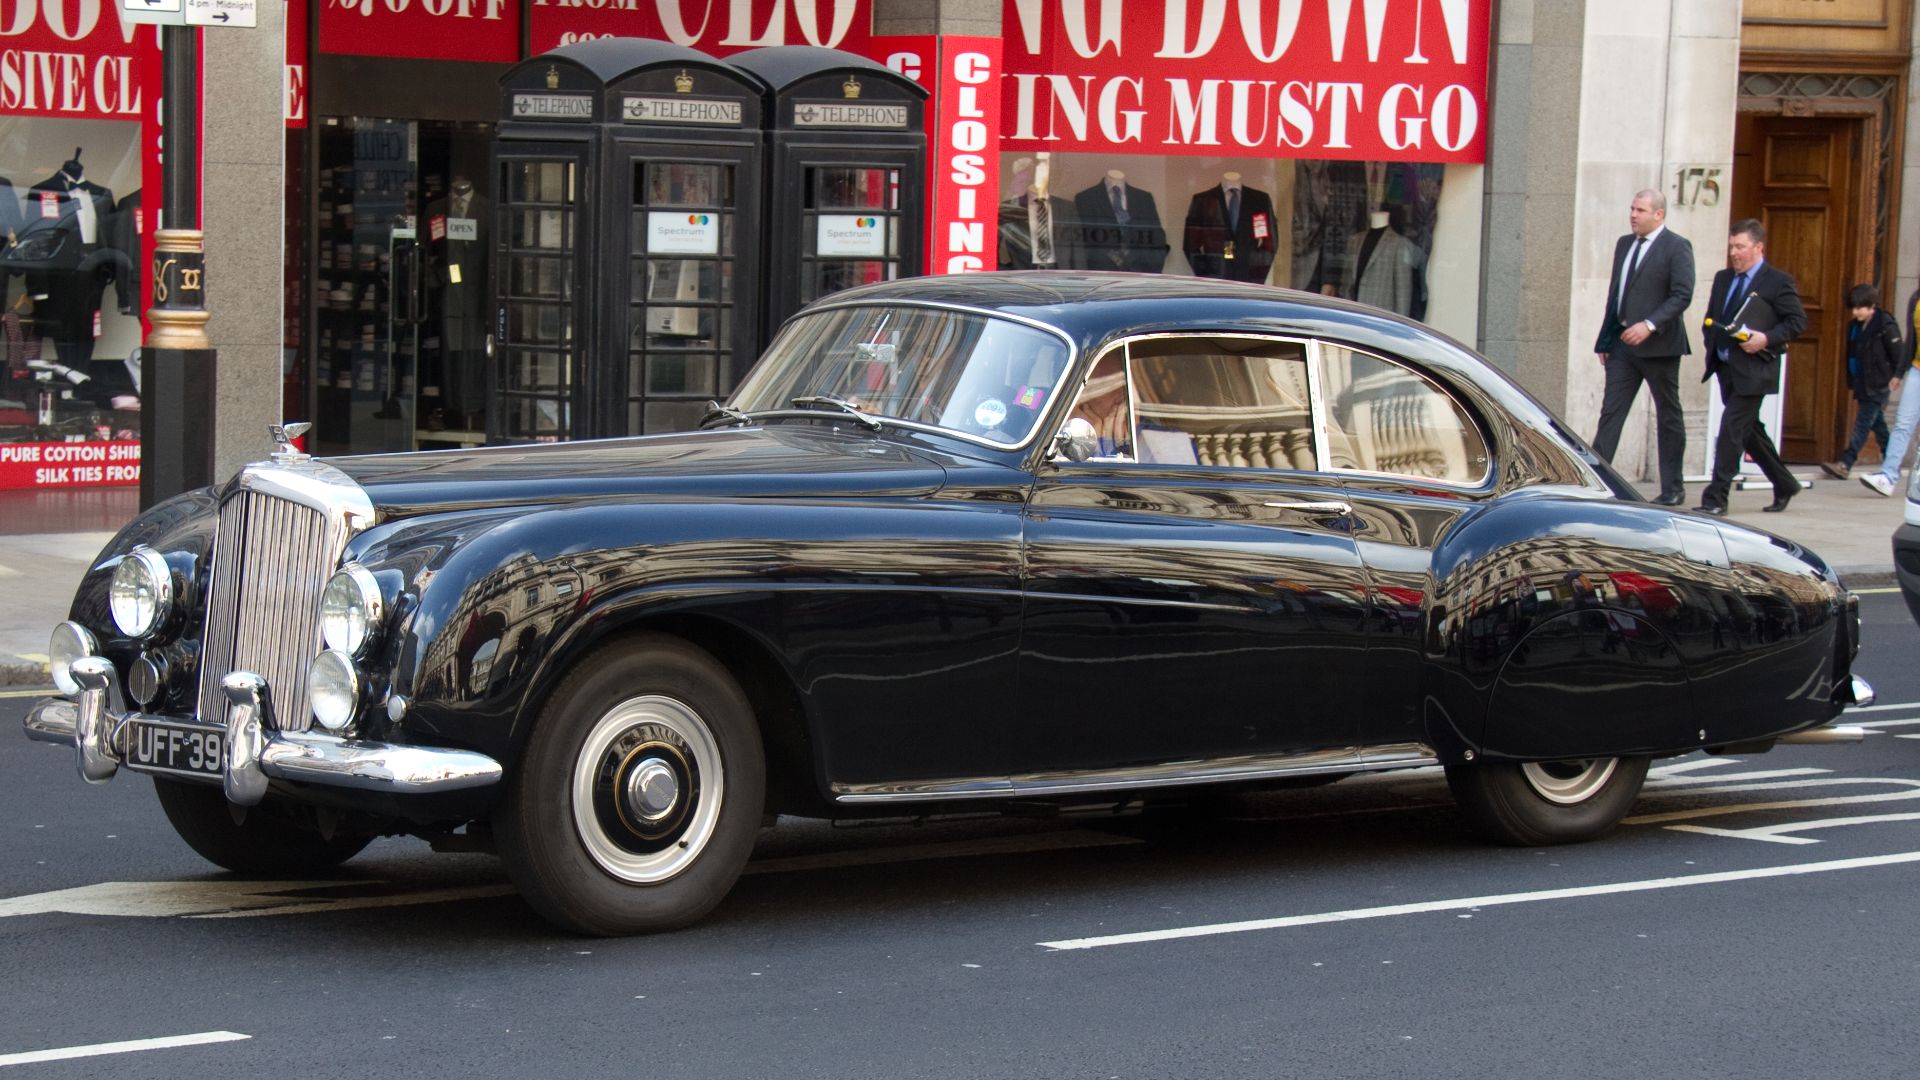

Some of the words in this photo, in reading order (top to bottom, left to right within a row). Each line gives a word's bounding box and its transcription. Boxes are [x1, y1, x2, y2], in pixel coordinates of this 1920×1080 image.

[0, 49, 86, 112] SIVE
[93, 55, 142, 114] CL
[532, 98, 593, 115] TELEPHONE
[651, 101, 741, 121] TELEPHONE
[820, 106, 906, 124] TELEPHONE
[1001, 74, 1148, 144] ING
[1162, 78, 1364, 149] MUST
[1378, 83, 1479, 152] GO
[1674, 168, 1722, 207] 175
[450, 224, 473, 233] OPEN
[657, 226, 705, 236] Spectrum
[827, 229, 872, 239] Spectrum
[1, 446, 41, 462] PURE
[44, 446, 106, 461] COTTON
[36, 468, 70, 484] SILK
[72, 466, 103, 482] TIES
[138, 725, 184, 766] UFF
